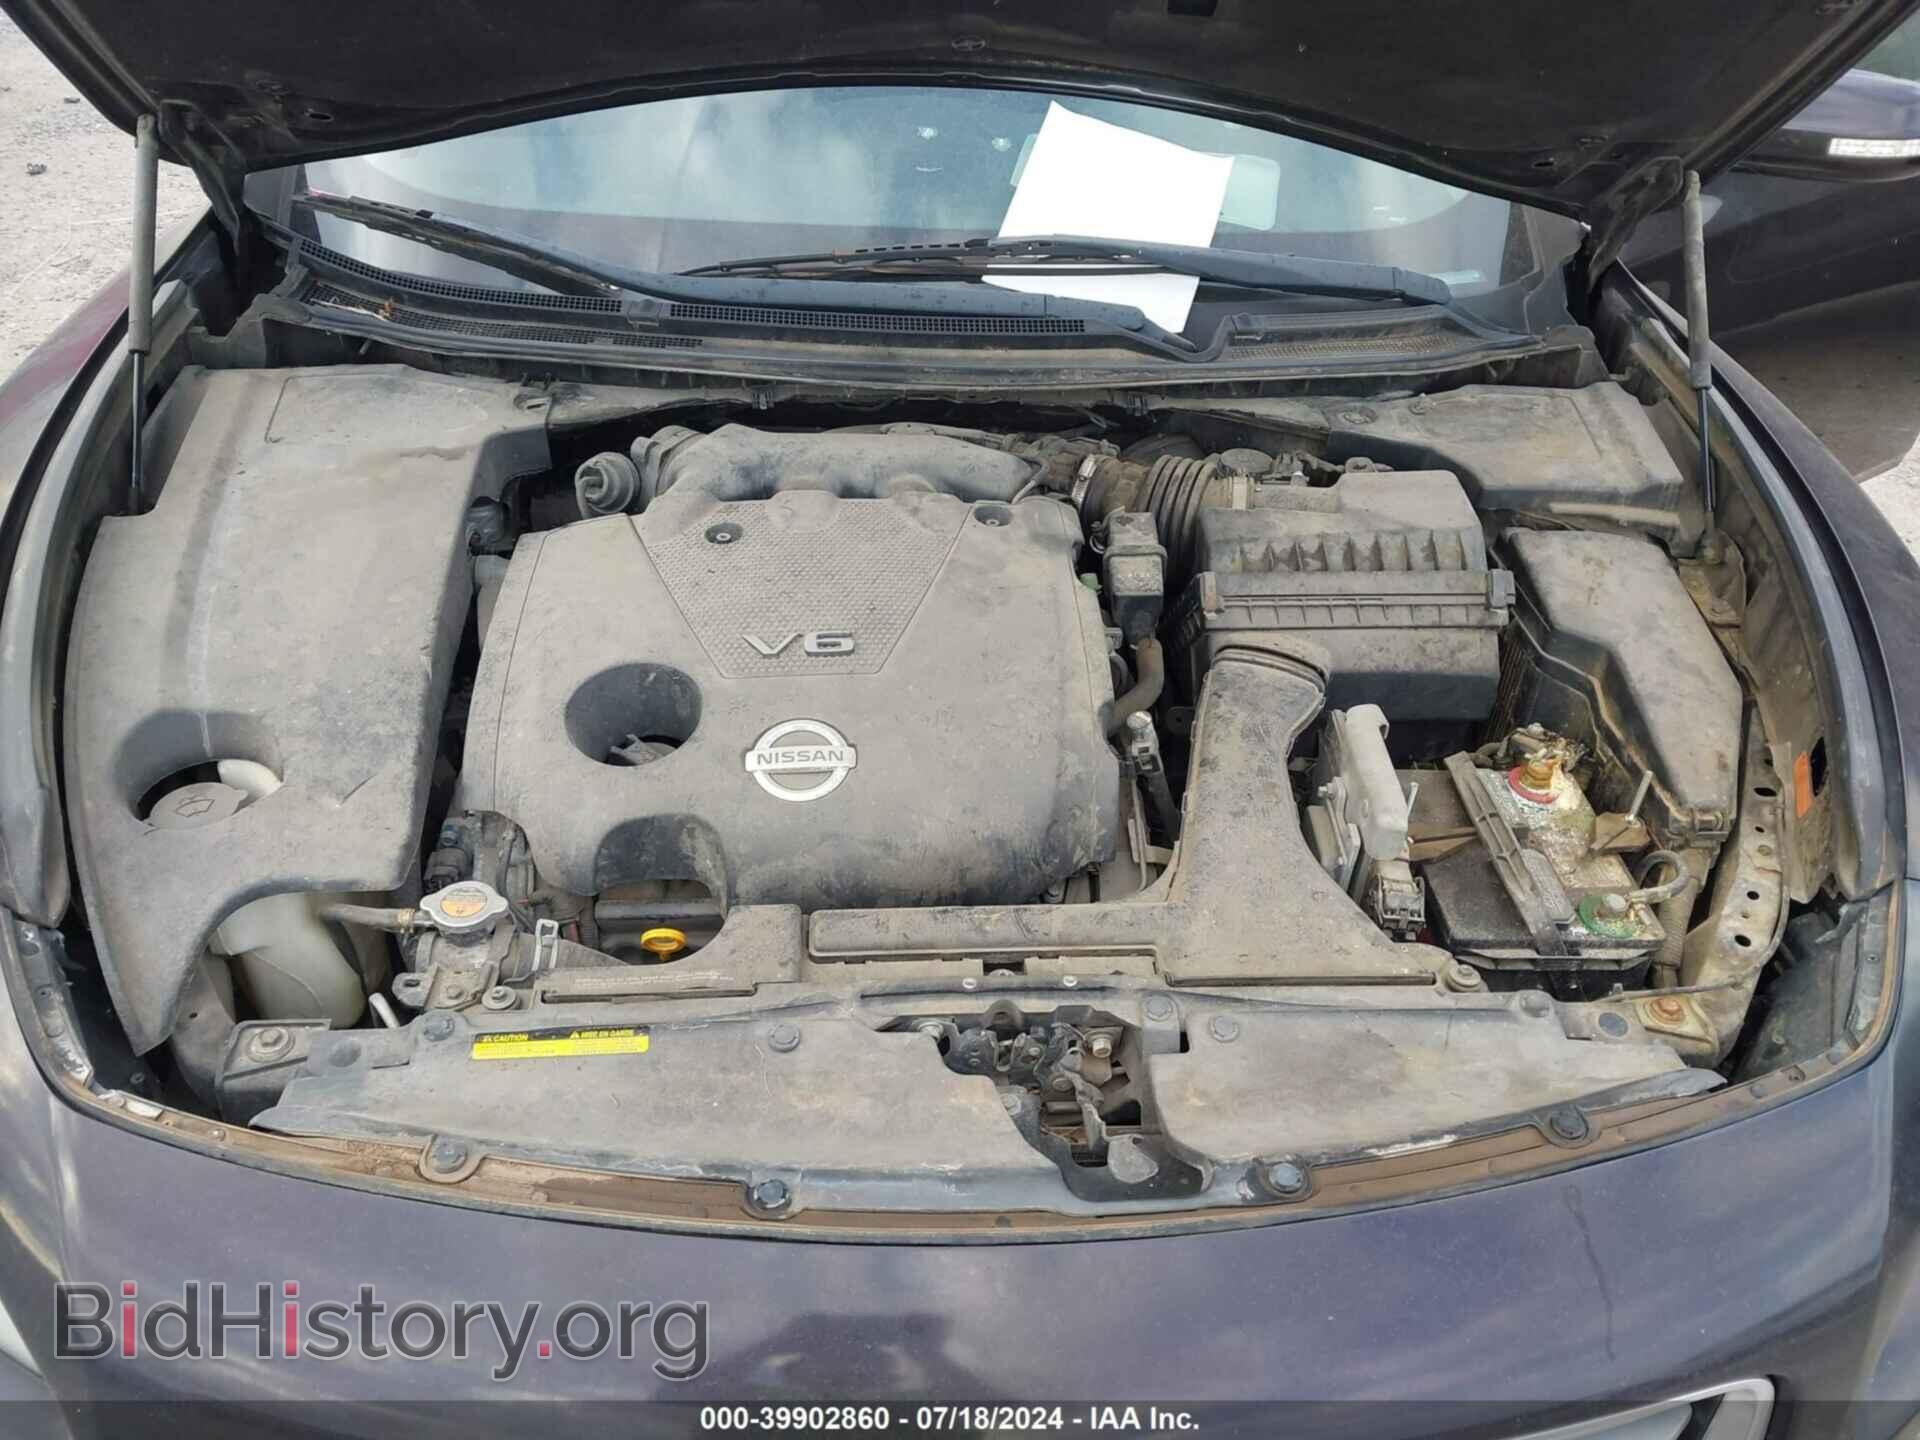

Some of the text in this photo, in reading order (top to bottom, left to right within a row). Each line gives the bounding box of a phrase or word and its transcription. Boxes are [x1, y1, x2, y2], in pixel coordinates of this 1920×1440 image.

[741, 630, 855, 656] V6
[757, 750, 844, 765] NISSAN
[494, 1033, 529, 1042] CAUTION
